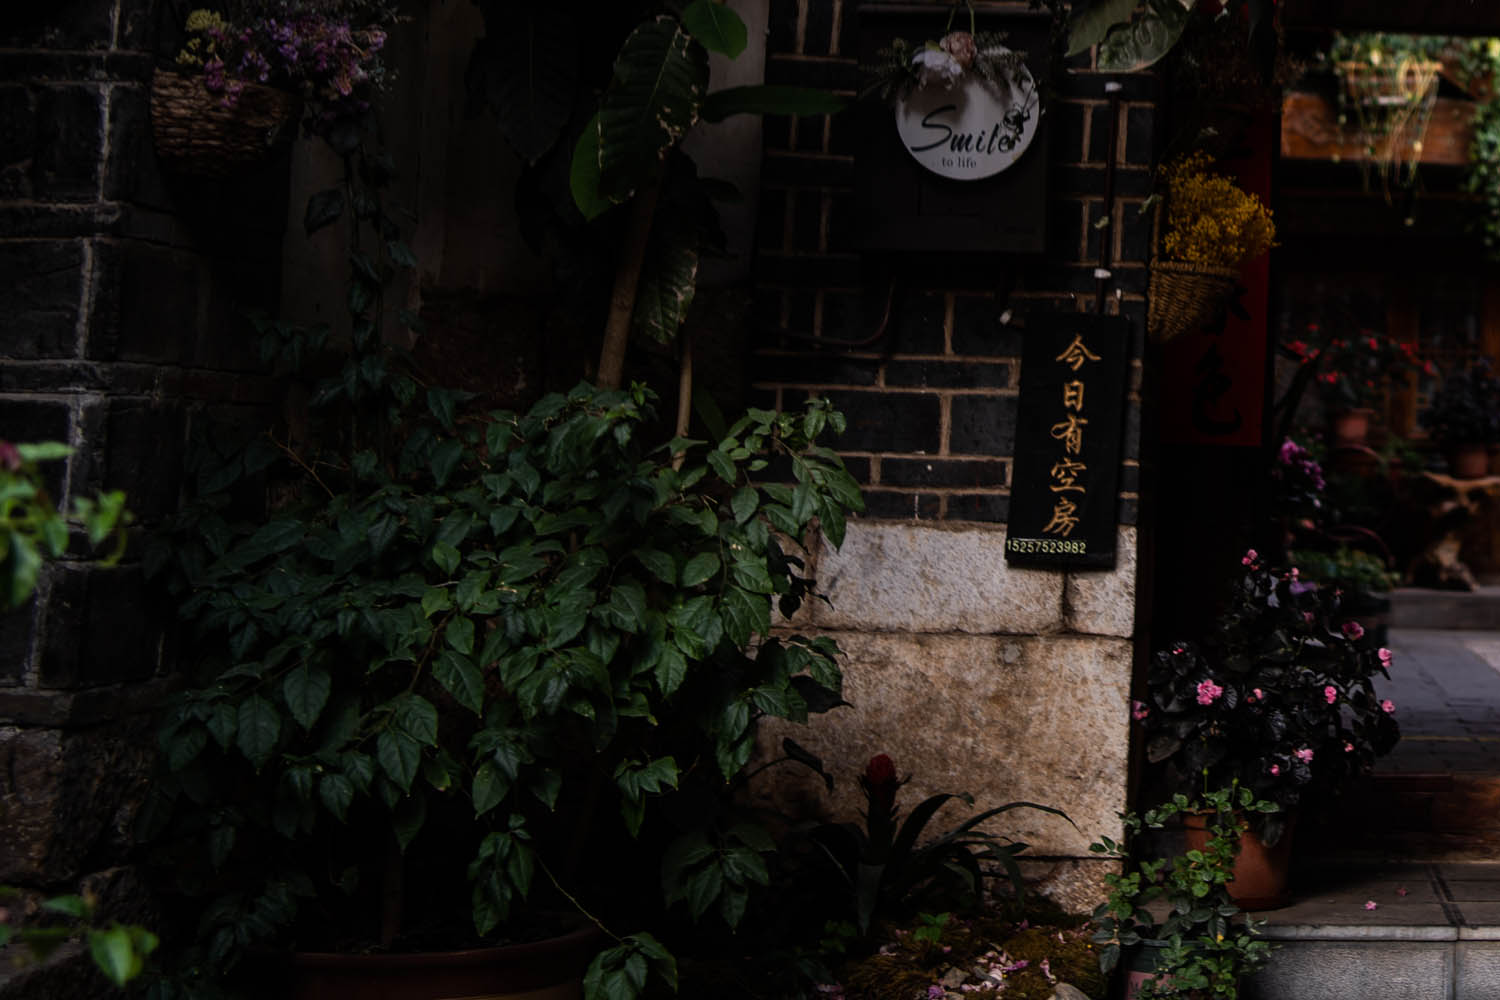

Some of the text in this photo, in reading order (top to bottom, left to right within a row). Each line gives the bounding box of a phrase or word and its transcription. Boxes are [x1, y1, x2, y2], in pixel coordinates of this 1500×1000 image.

[911, 105, 1014, 155] Smile
[942, 156, 977, 169] to life
[1042, 331, 1103, 537] 今日有空房
